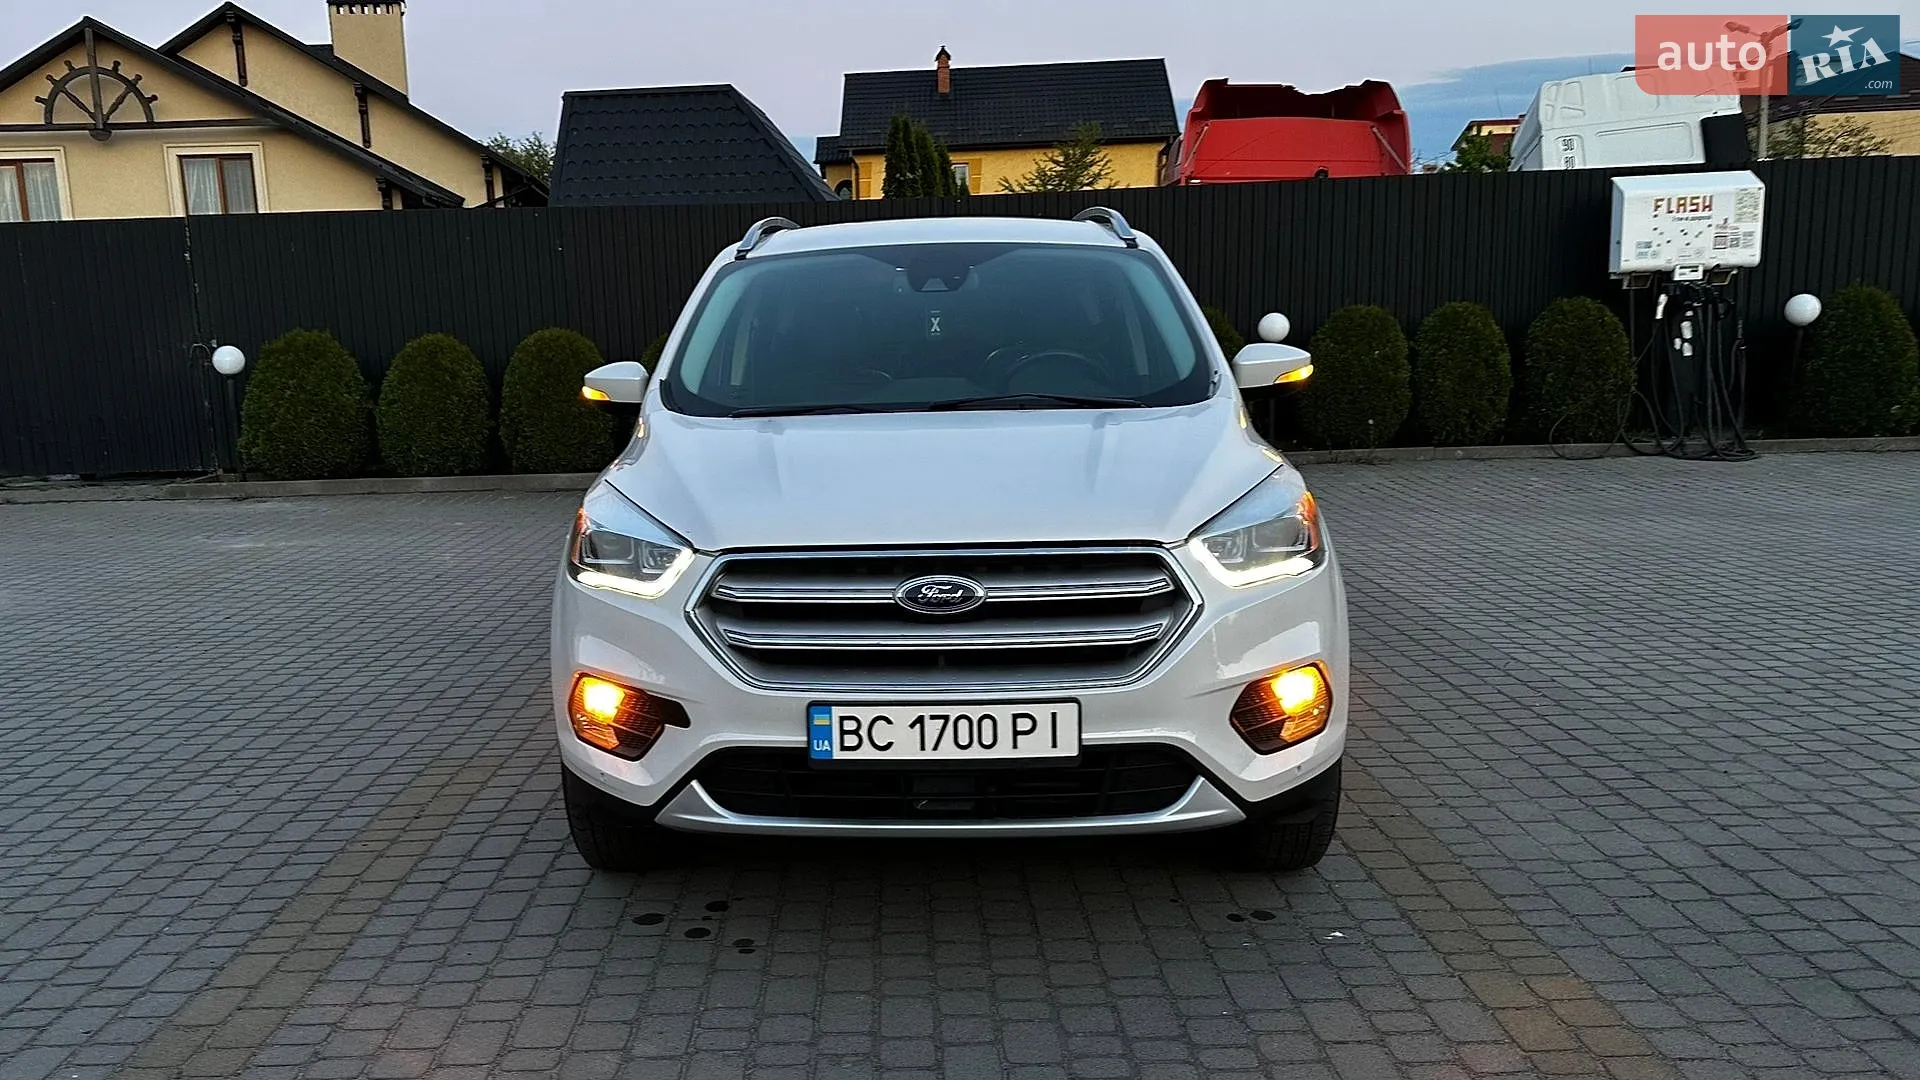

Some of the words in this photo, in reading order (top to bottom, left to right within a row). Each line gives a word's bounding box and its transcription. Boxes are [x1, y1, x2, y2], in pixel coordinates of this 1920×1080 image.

[1561, 138, 1575, 151] 90
[1653, 195, 1713, 214] FLASH
[918, 584, 964, 603] Ford
[838, 714, 895, 752] BC
[908, 713, 998, 751] 1700
[813, 739, 831, 751] UA
